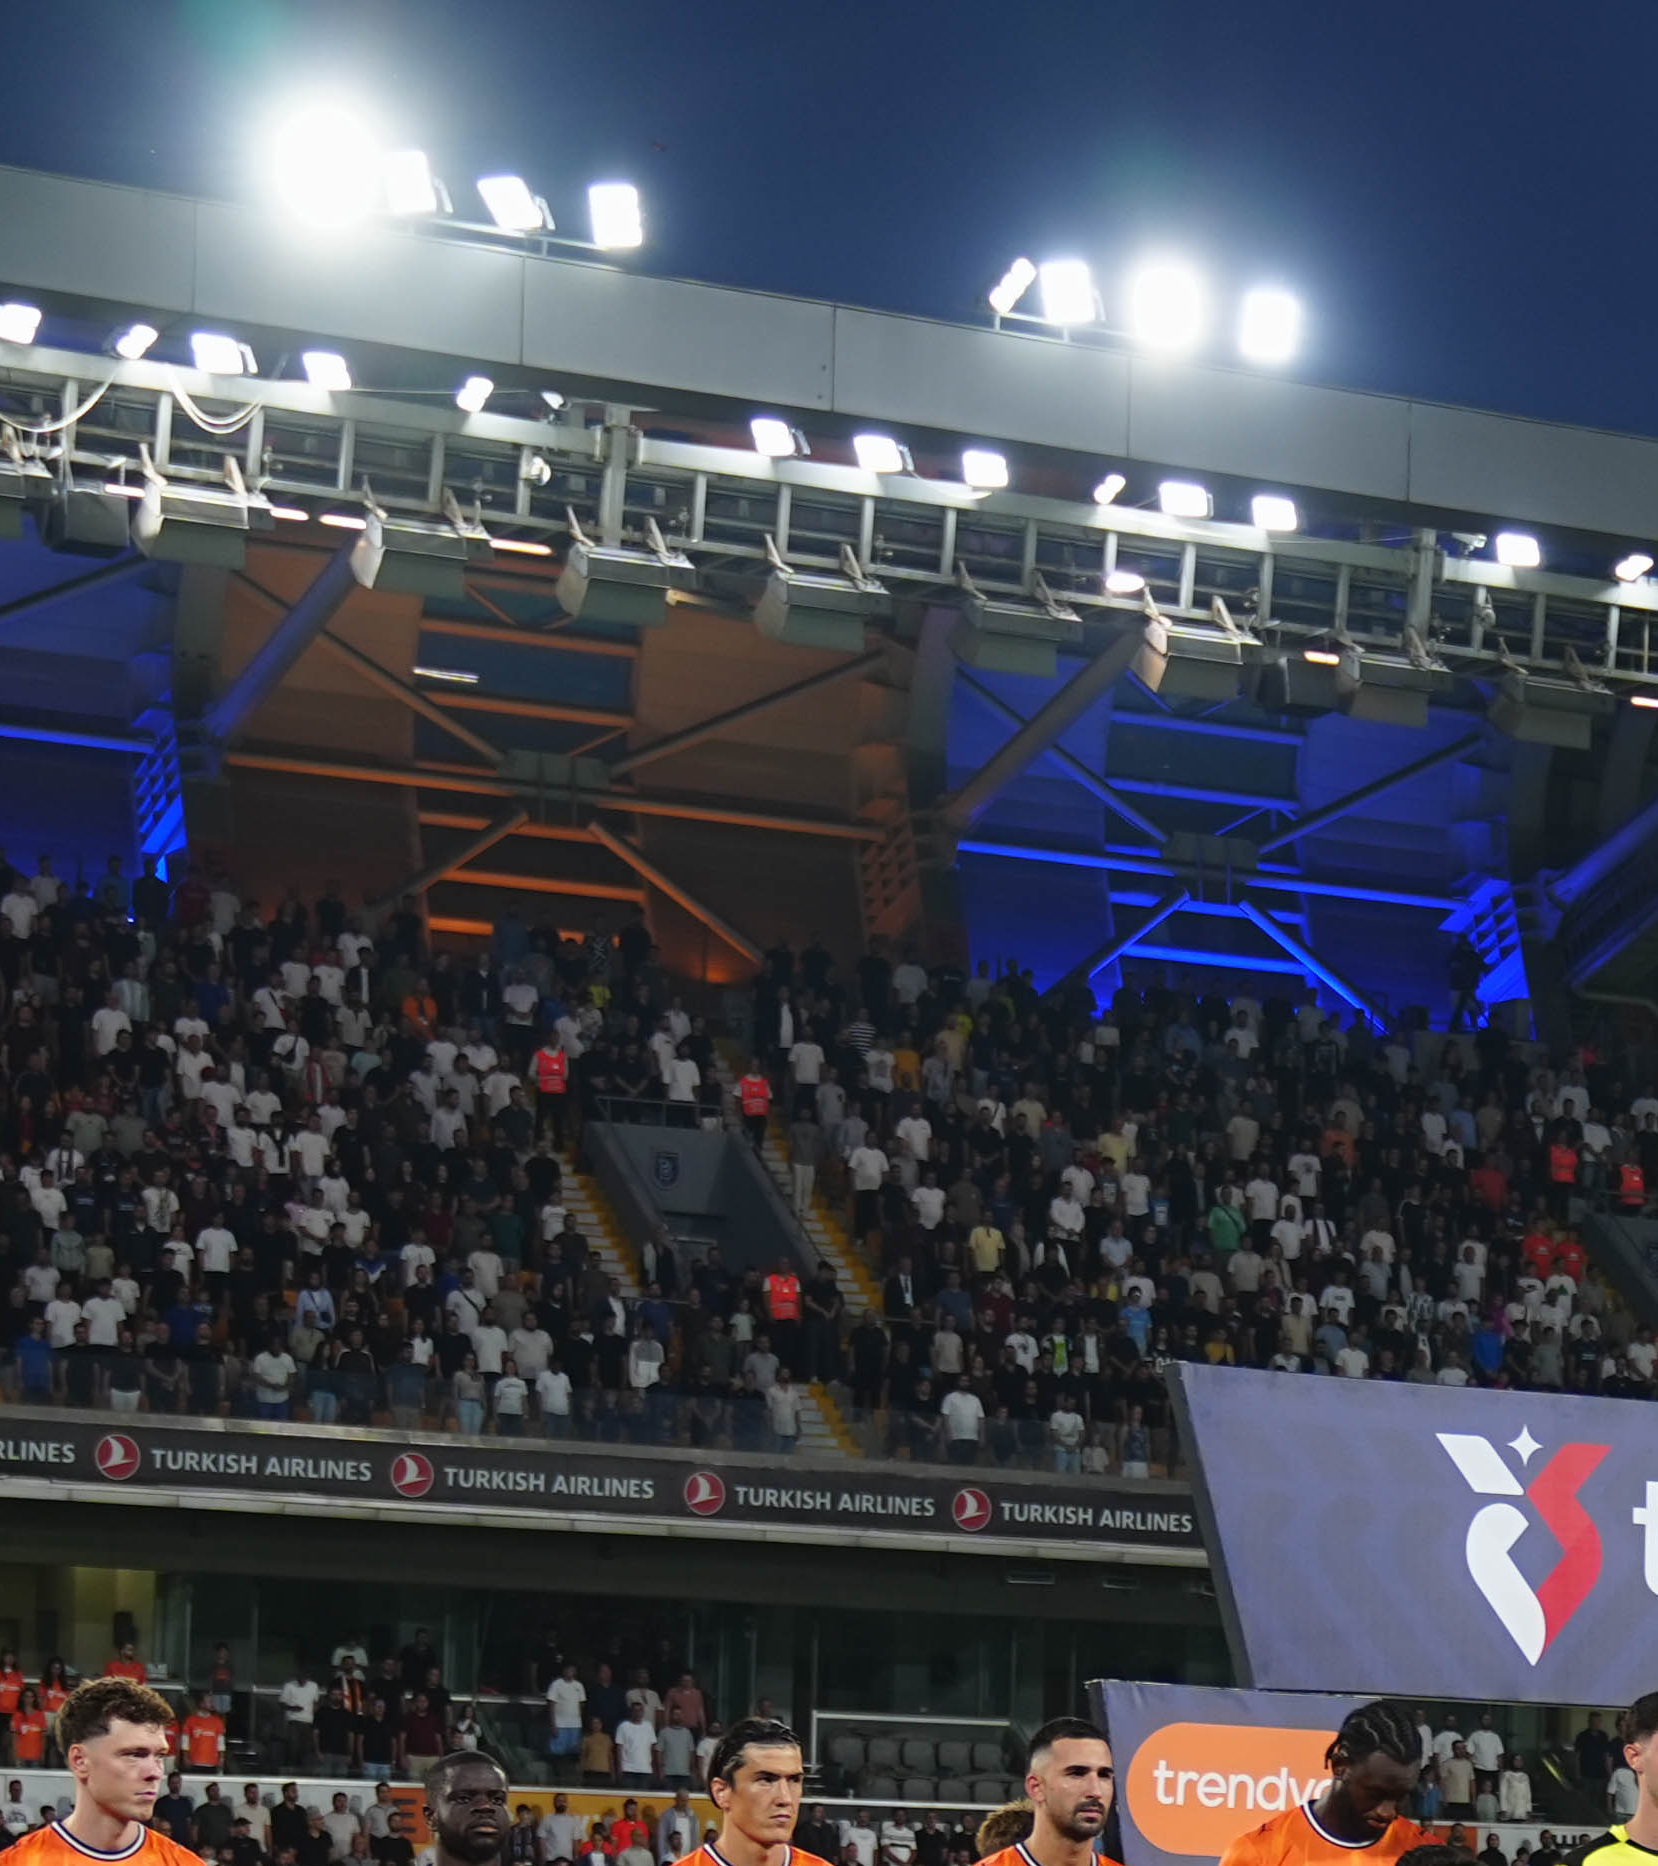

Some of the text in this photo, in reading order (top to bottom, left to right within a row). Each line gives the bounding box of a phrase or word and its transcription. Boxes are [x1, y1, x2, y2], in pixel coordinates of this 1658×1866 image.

[152, 1450, 371, 1481] TURKISH AIRLINES
[445, 1468, 653, 1498] TURKISH AIRLINES
[735, 1487, 934, 1516] TURKISH AIRLINES
[1001, 1503, 1192, 1532] TURKISH AIRLINES
